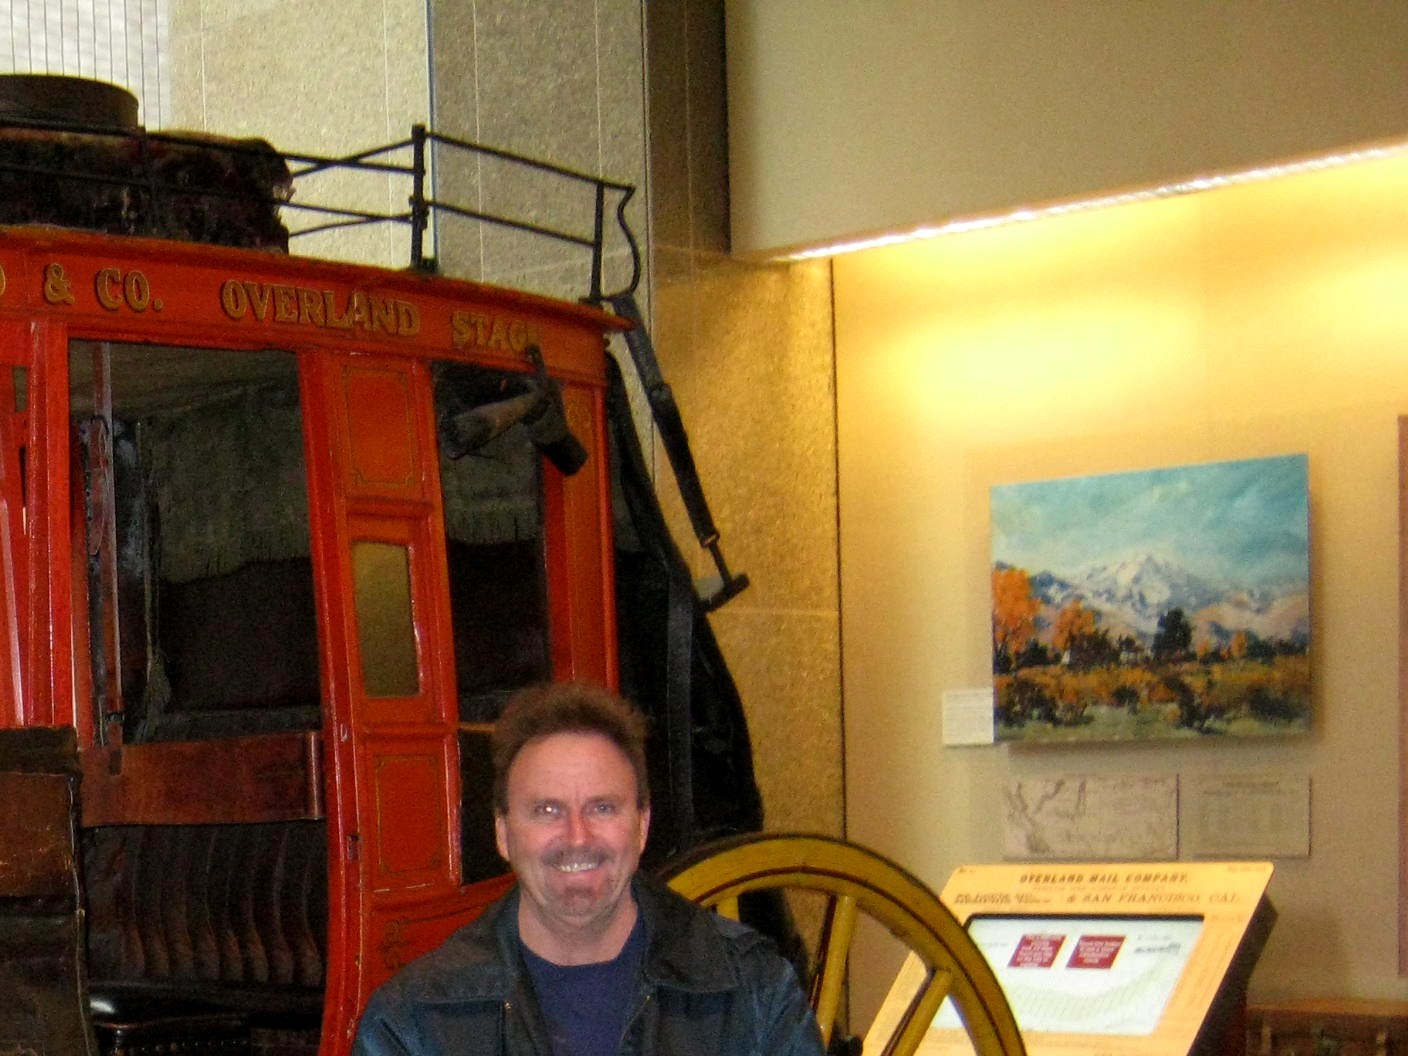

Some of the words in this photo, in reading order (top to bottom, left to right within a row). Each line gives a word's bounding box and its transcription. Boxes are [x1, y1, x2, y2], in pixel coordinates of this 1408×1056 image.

[44, 263, 75, 305] &
[95, 268, 163, 312] CO.
[221, 279, 421, 337] OVERLAND
[1019, 872, 1084, 884] OVERLAND
[1089, 872, 1118, 884] MAIL
